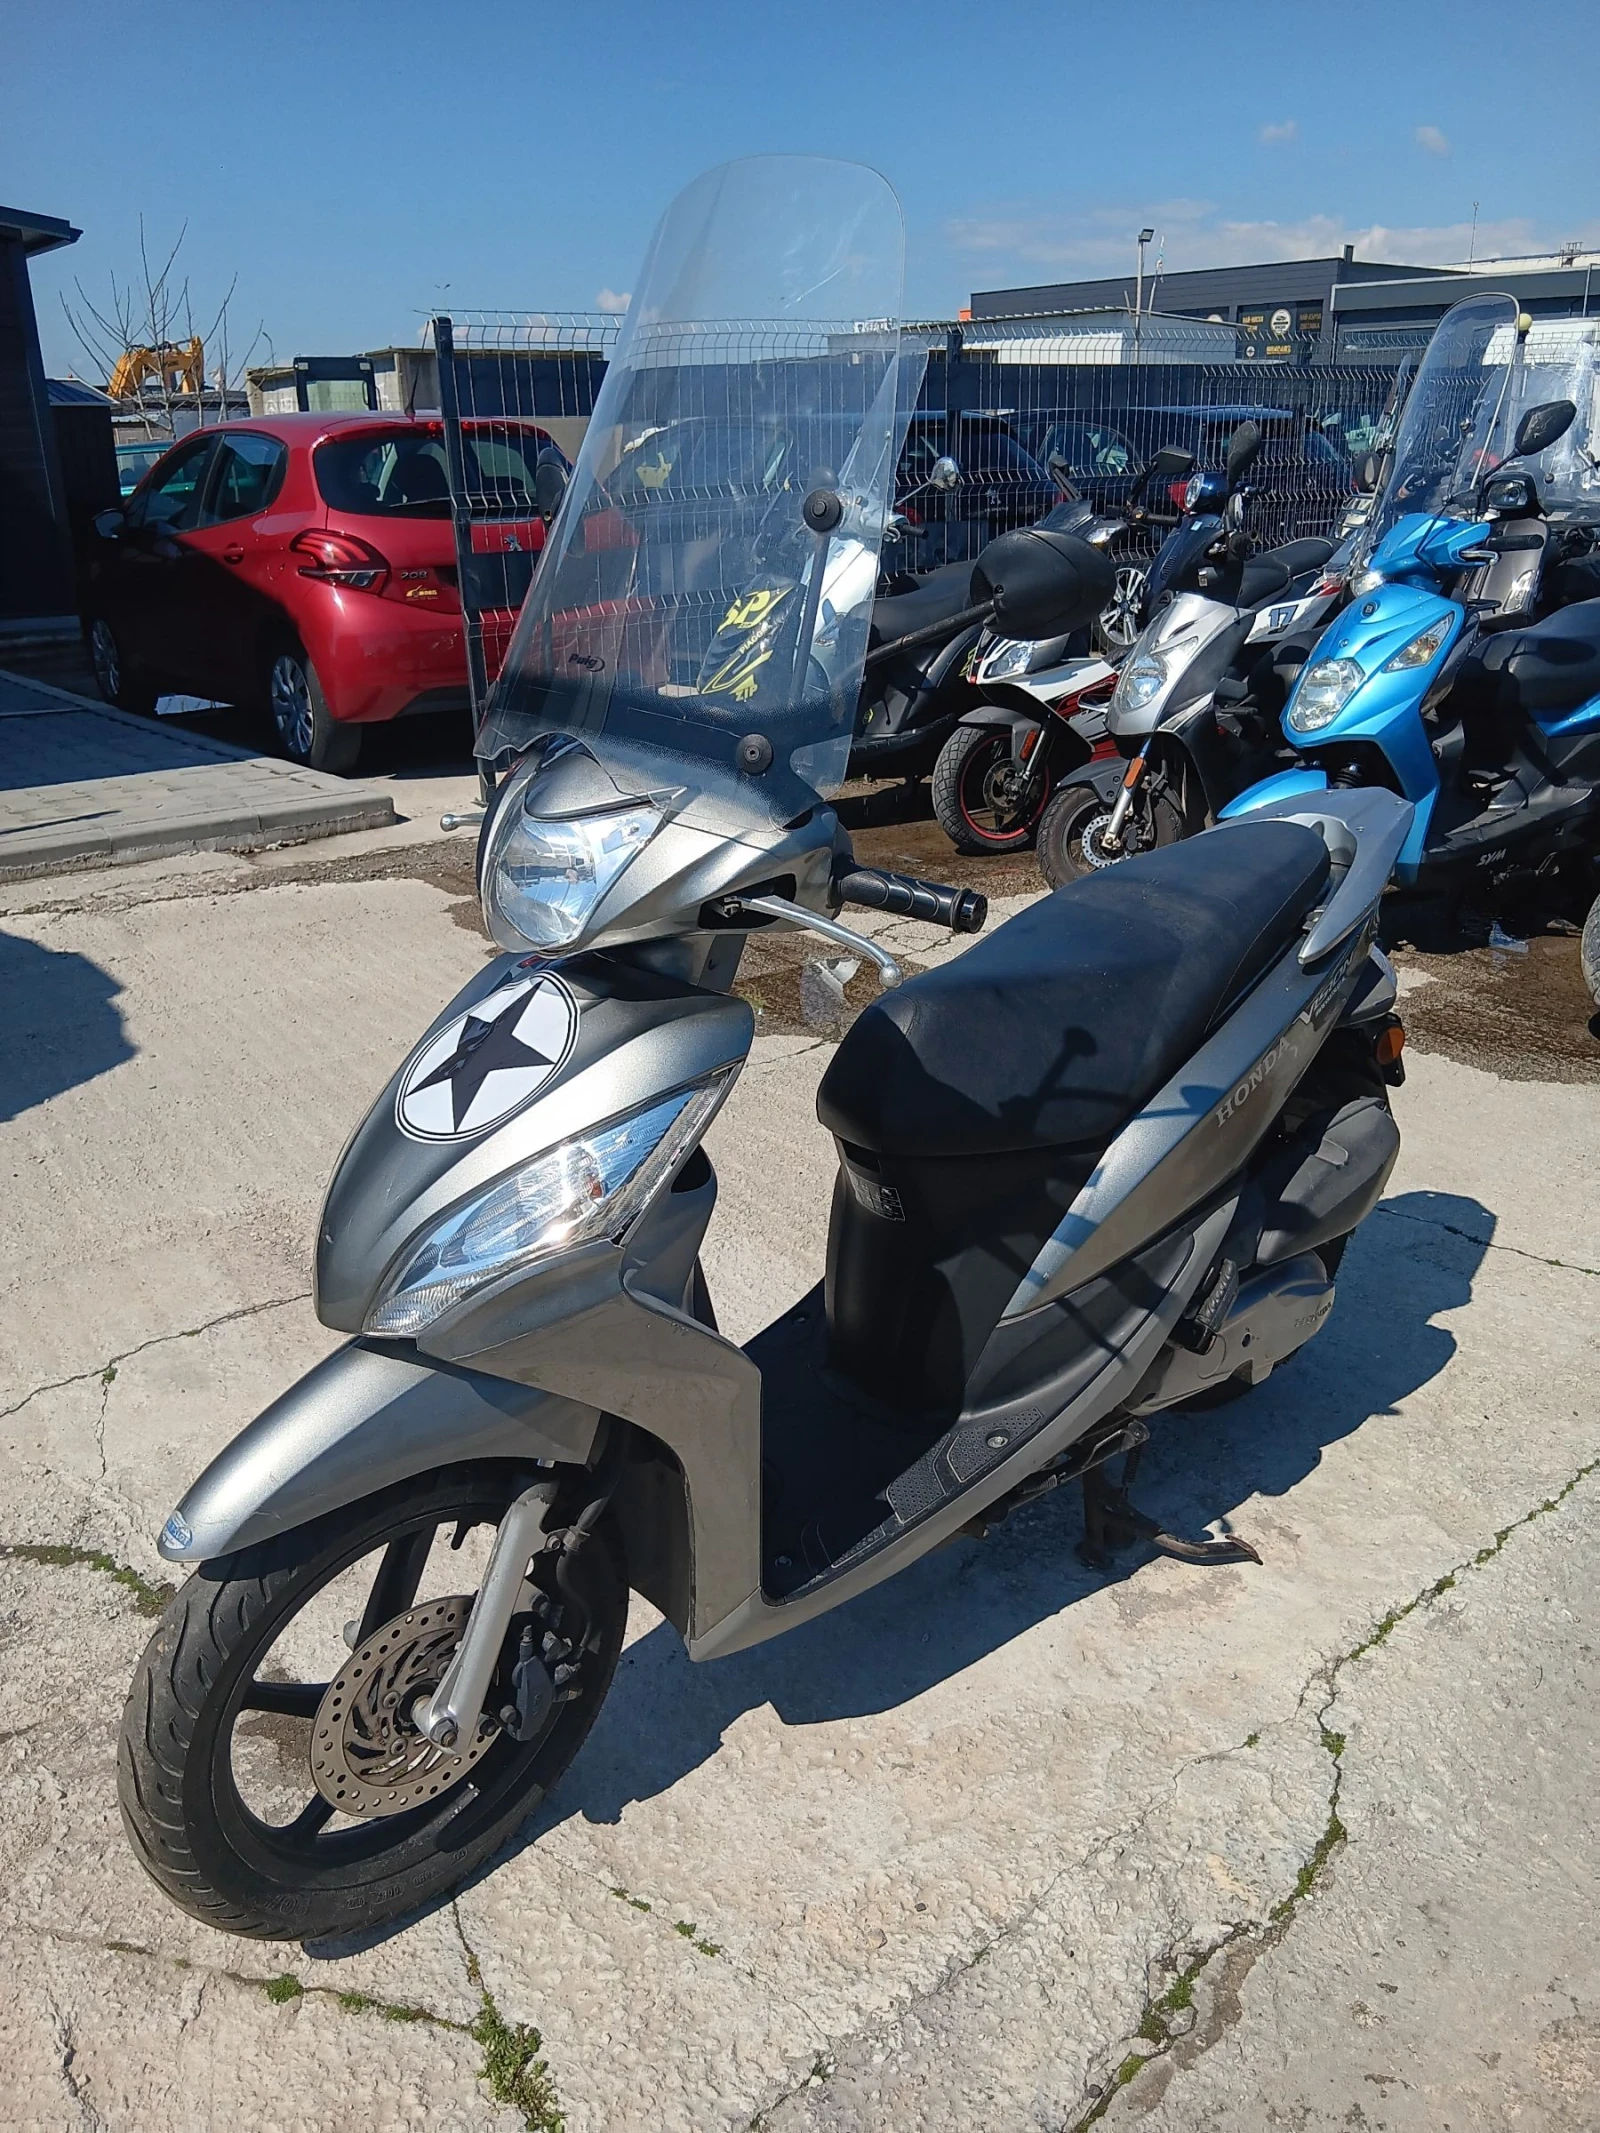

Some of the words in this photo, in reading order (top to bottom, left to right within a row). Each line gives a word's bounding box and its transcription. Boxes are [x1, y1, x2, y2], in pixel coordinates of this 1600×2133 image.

[401, 570, 428, 579] 208
[1268, 604, 1299, 629] 17
[739, 619, 770, 655] PIAGG
[568, 653, 598, 669] Puig
[735, 683, 758, 702] ZIP
[1476, 848, 1507, 867] SYM
[1215, 1035, 1291, 1128] HONDA
